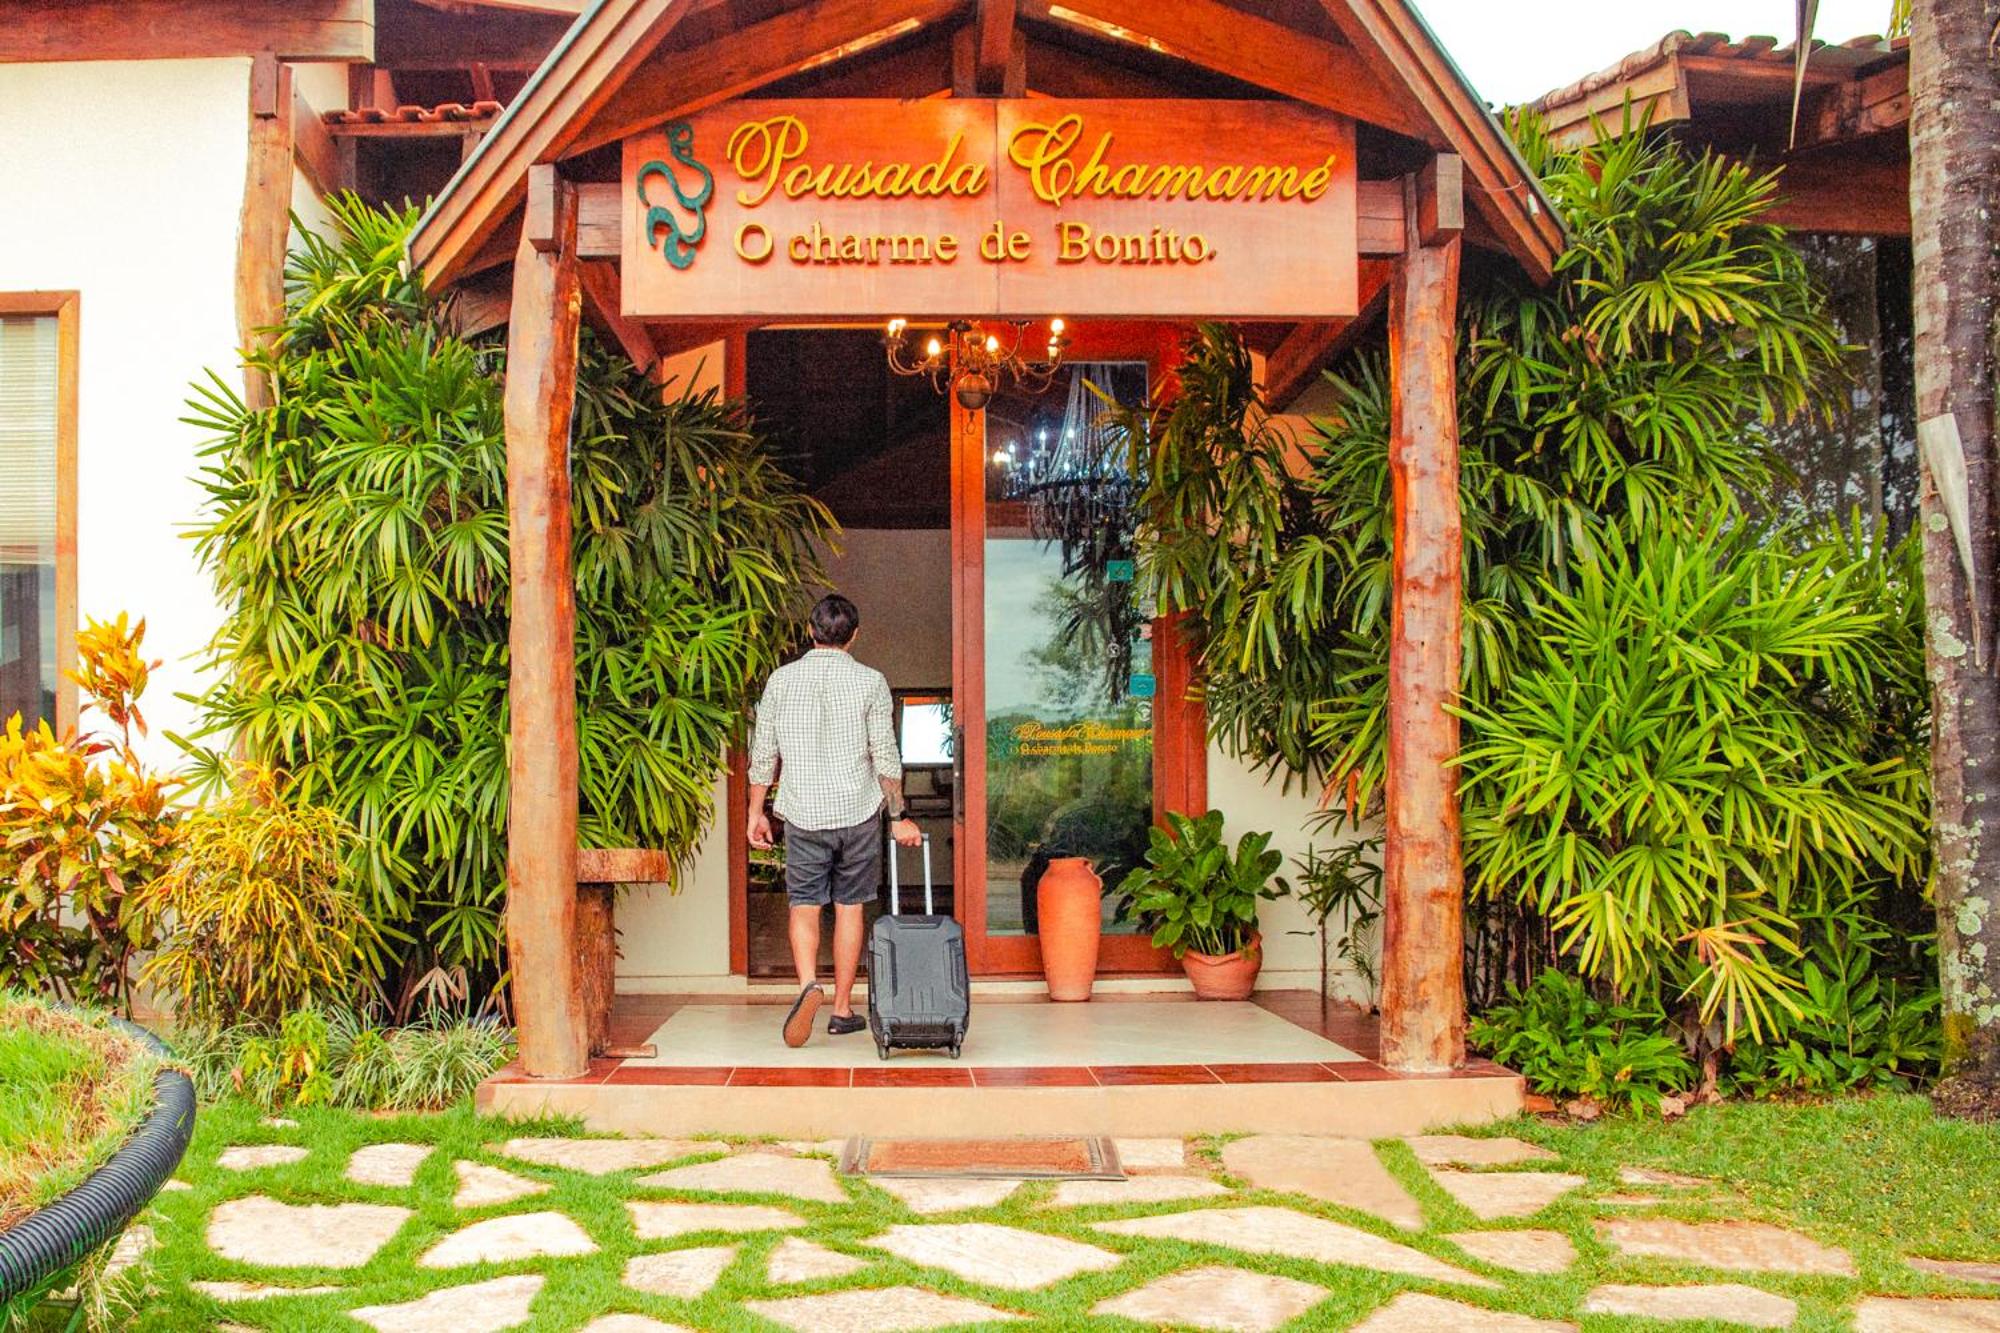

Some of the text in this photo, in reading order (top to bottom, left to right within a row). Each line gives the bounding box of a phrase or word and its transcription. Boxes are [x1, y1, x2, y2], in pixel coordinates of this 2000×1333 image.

[727, 113, 1337, 208] Pousada Chamamé
[733, 219, 1218, 264] O charme de Bonito.
